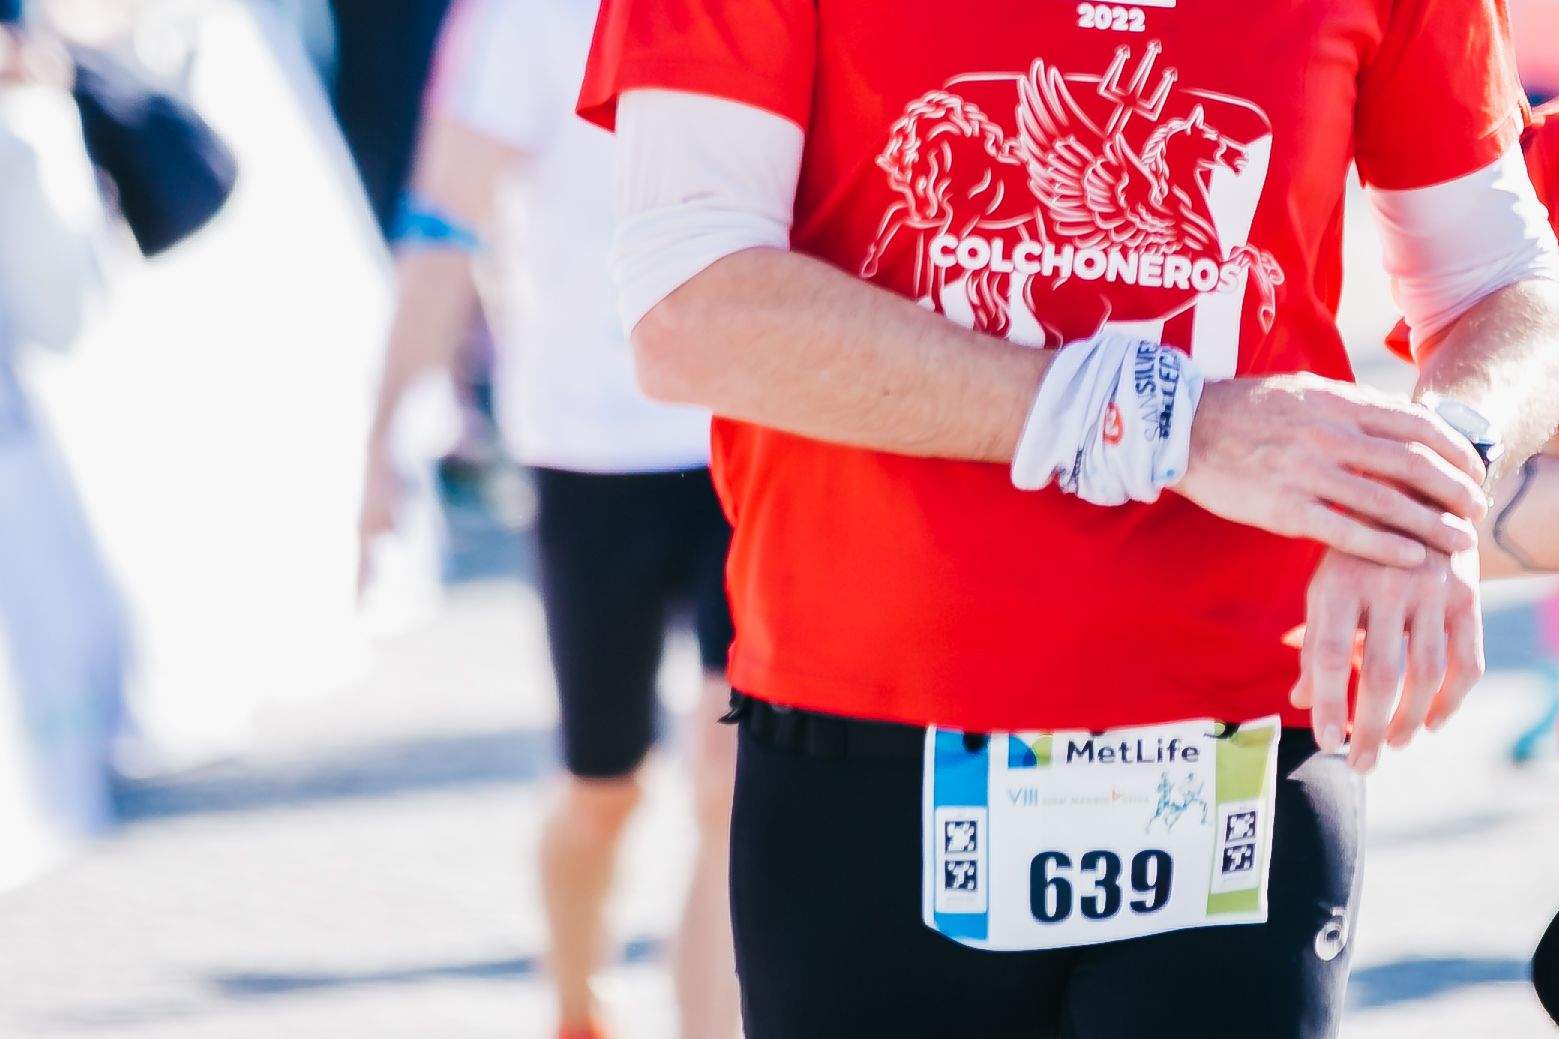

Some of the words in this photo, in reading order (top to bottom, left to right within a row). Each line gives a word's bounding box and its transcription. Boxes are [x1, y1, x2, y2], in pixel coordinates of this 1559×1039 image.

[1077, 3, 1145, 32] 2022
[929, 234, 1243, 293] COLCHONEROS
[1066, 737, 1200, 764] MetLife
[1029, 849, 1172, 923] 639
